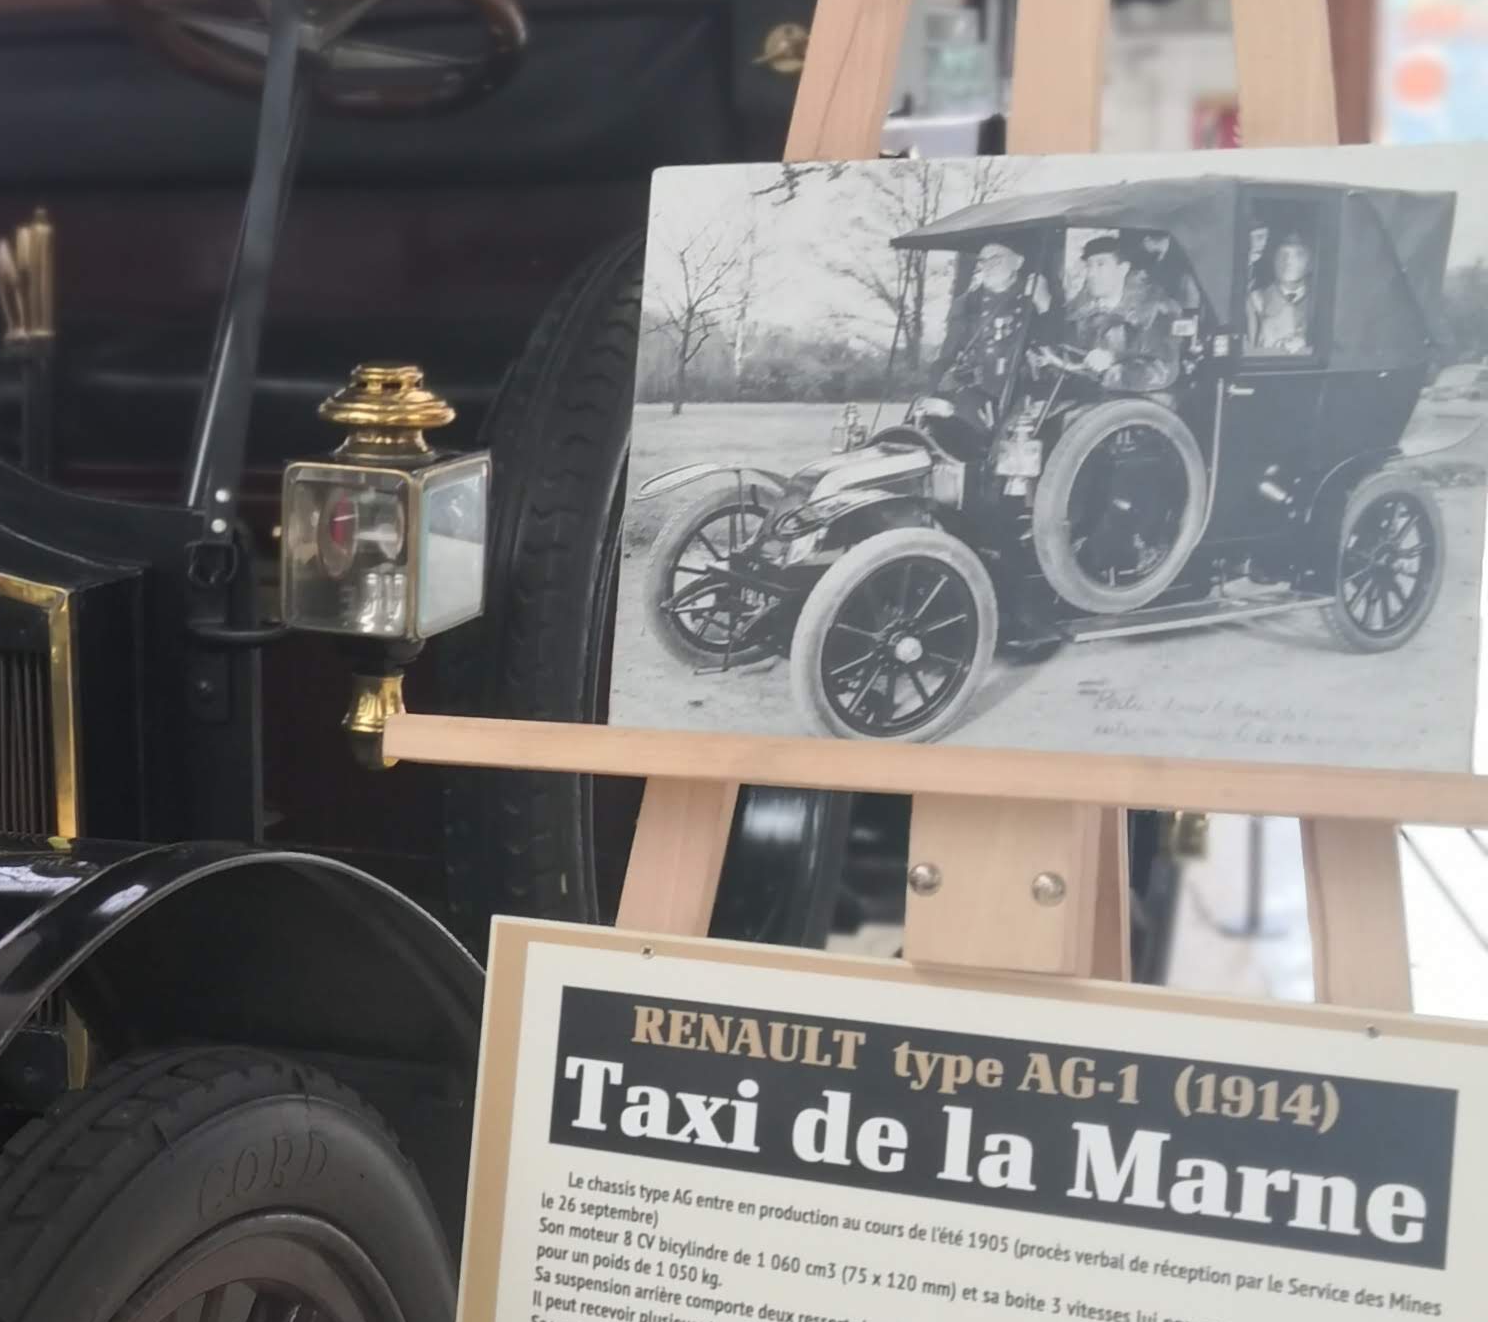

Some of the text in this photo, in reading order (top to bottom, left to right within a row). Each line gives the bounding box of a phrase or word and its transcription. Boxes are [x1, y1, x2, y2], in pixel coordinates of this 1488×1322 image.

[630, 1005, 1342, 1136] RENAULT type AG-1 (1914)
[560, 1055, 1431, 1247] Taxi de la Marne
[535, 1245, 569, 1266] pour
[570, 1251, 589, 1266] un
[591, 1250, 631, 1276] poids
[633, 1257, 652, 1276] de
[667, 1263, 698, 1283] 050
[700, 1268, 722, 1290] kg.
[566, 1172, 1443, 1317] Le chassis type AG entre en production au cours de l'été 1905 (procès verbal de réception par le Service des Mines
[531, 1291, 543, 1308] Il
[544, 1293, 577, 1317] peut
[533, 1266, 552, 1285] Sa
[553, 1270, 631, 1301] suspension
[633, 1283, 683, 1307] arrière
[684, 1291, 755, 1322] comporte
